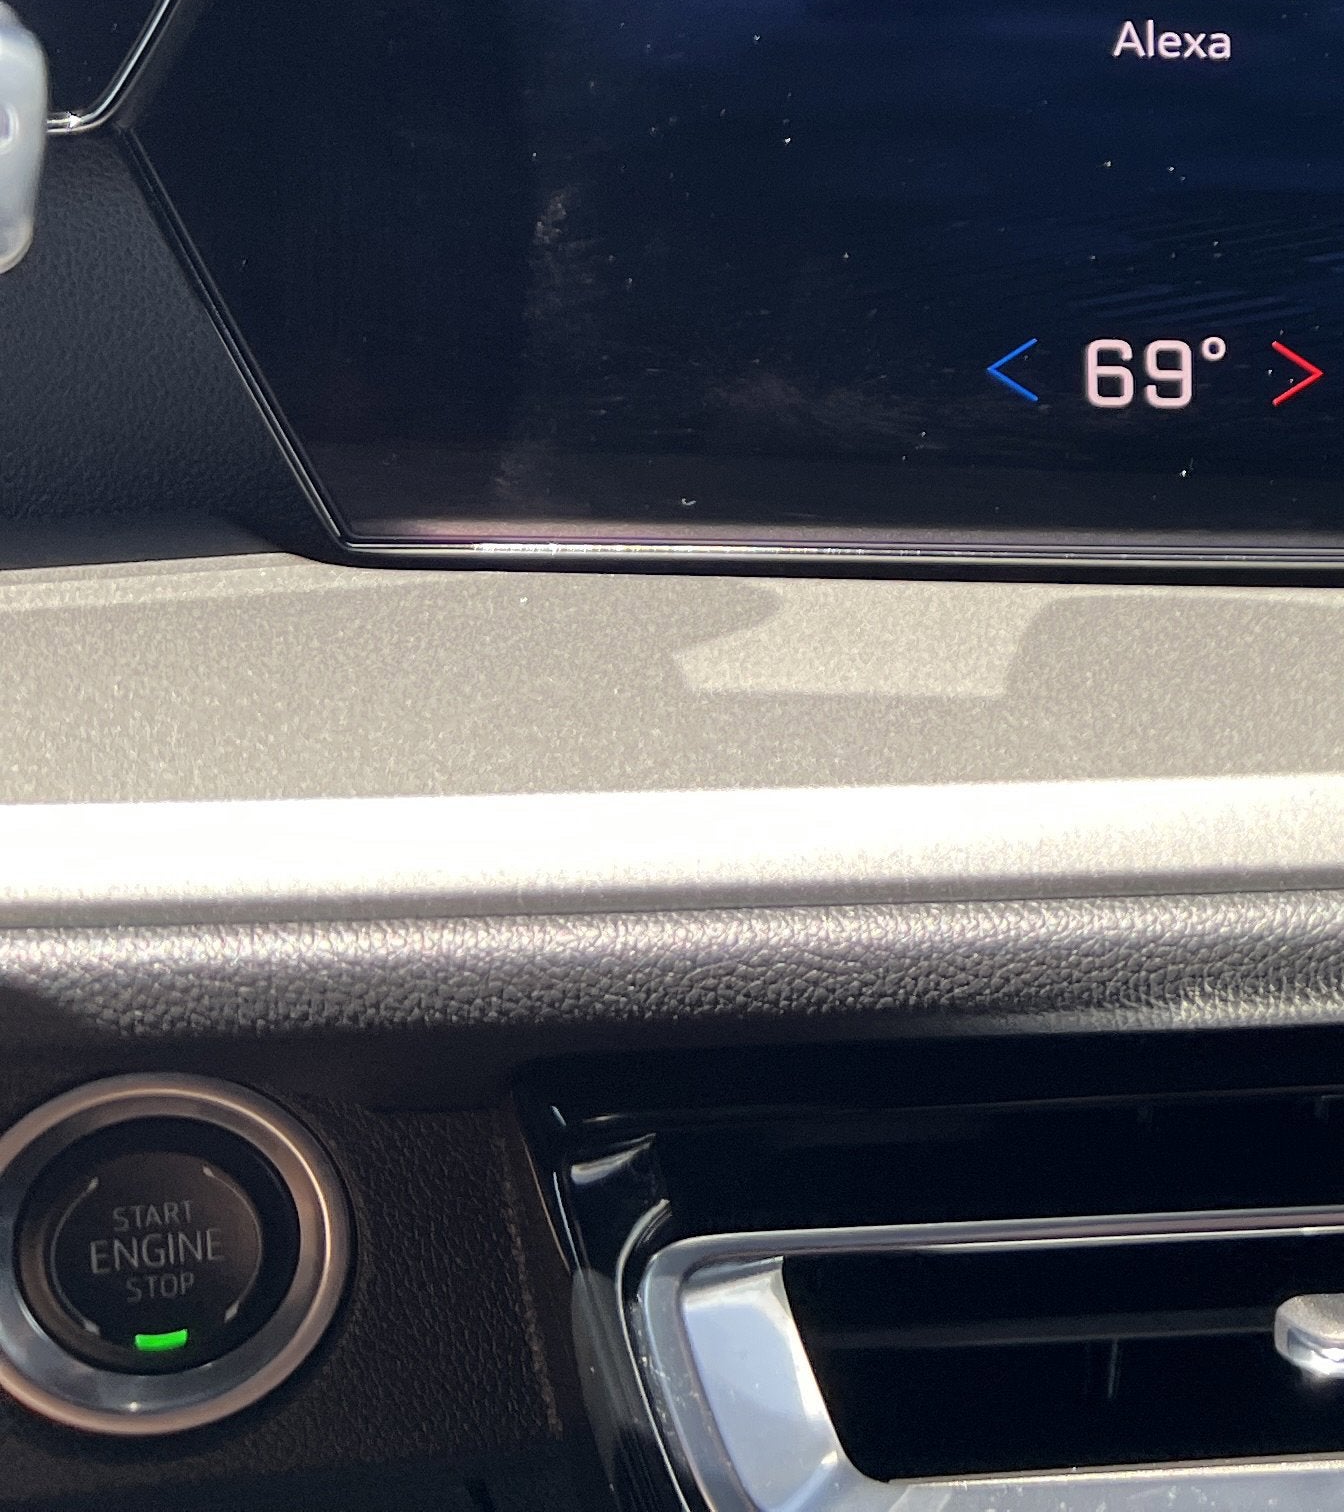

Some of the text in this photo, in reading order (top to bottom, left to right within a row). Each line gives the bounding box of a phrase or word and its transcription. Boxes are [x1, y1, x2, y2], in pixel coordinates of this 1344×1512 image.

[1112, 18, 1232, 60] Alexa
[1085, 335, 1227, 409] 69°
[113, 1201, 193, 1230] START
[89, 1229, 226, 1274] ENGINE
[127, 1274, 195, 1303] STOP
